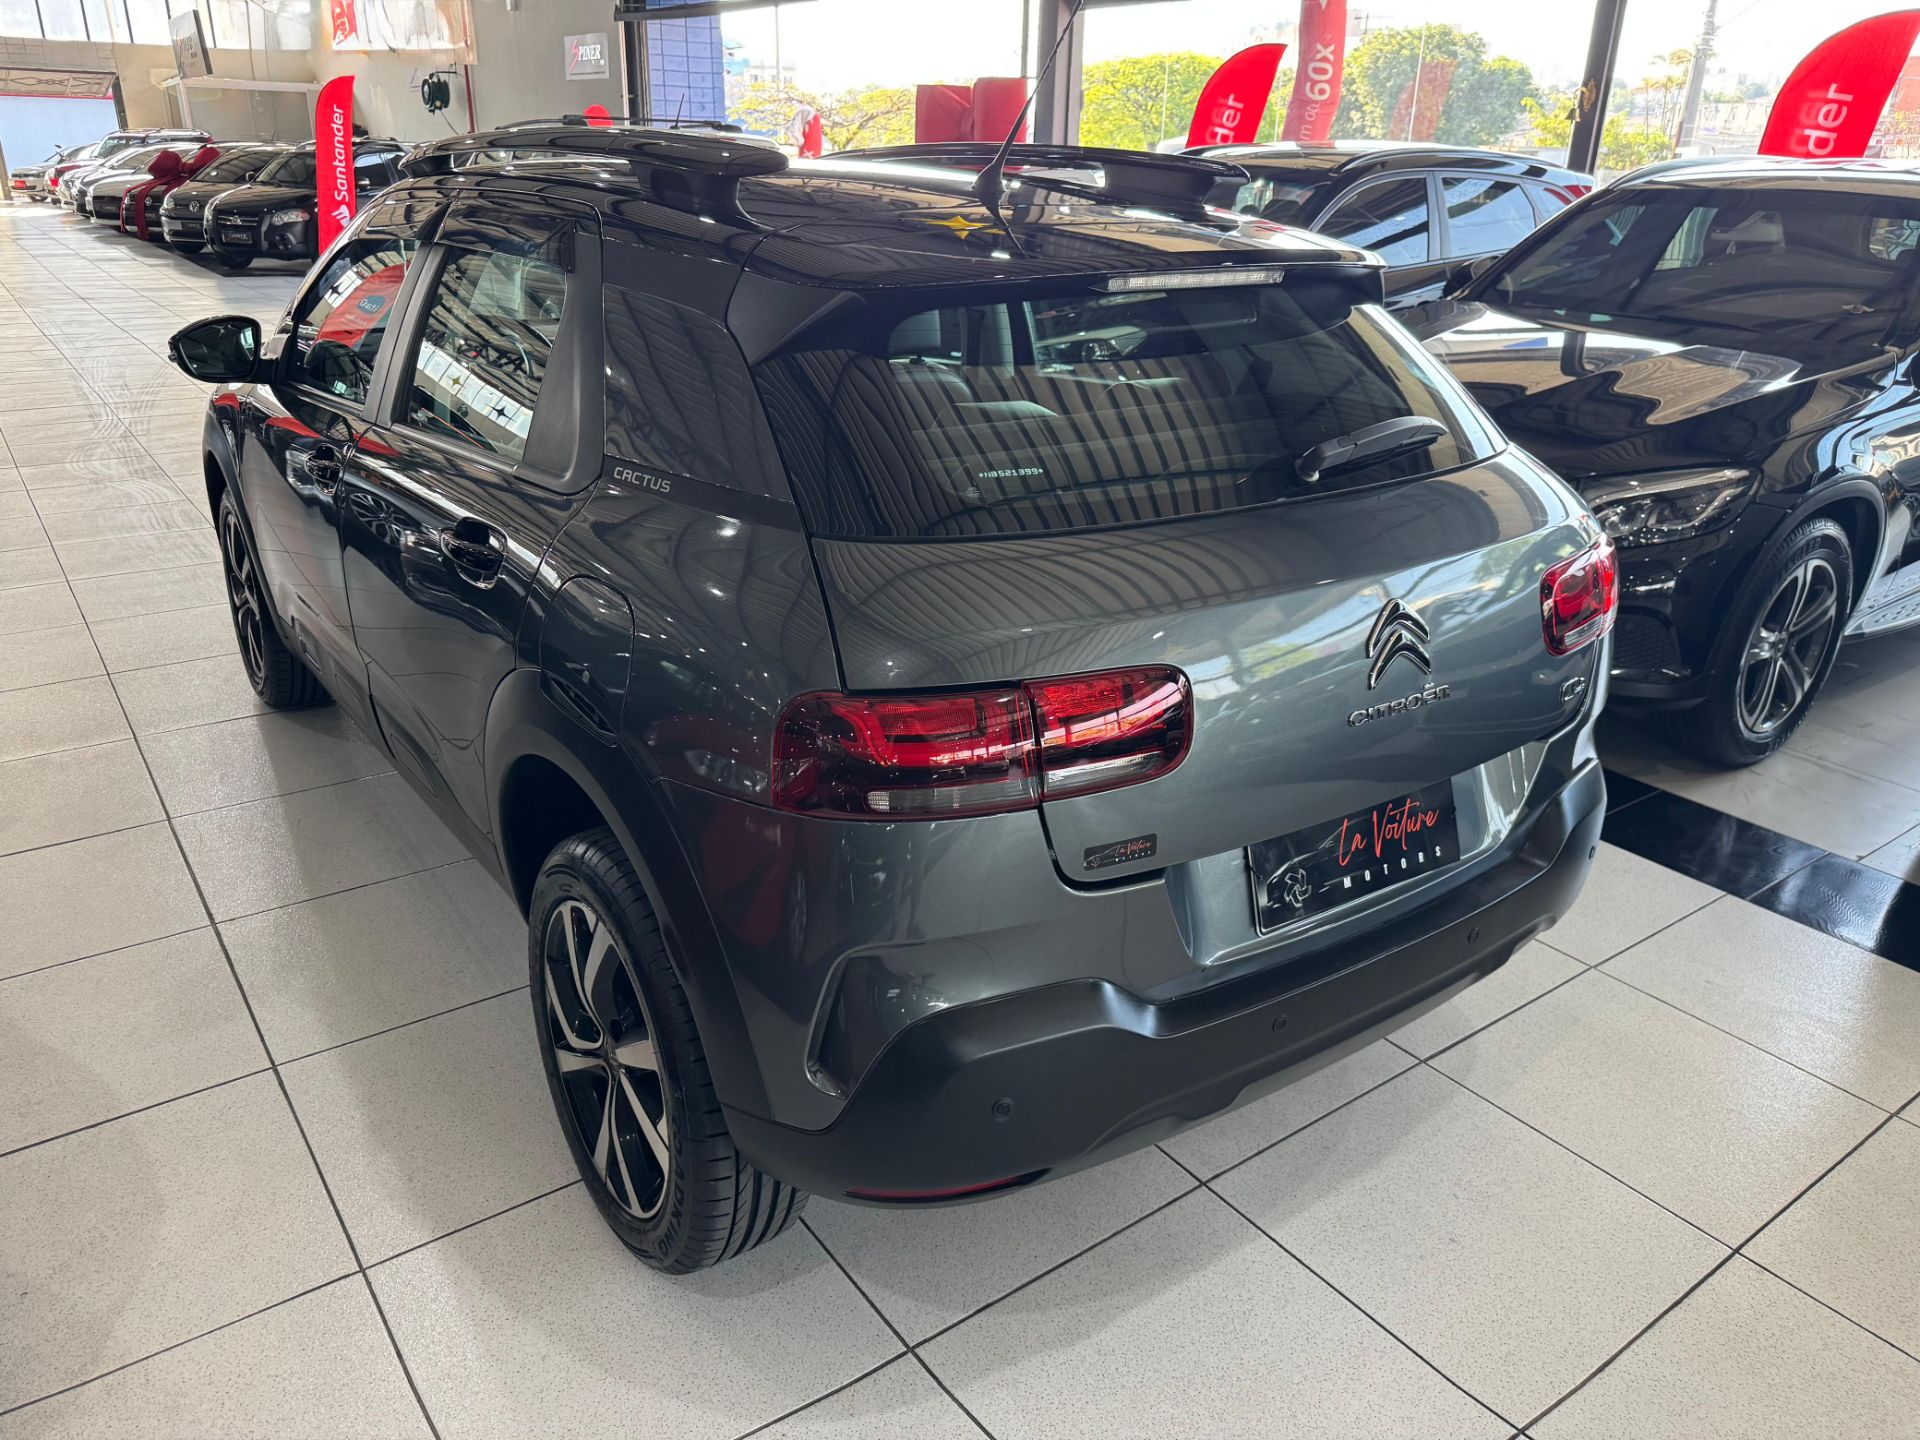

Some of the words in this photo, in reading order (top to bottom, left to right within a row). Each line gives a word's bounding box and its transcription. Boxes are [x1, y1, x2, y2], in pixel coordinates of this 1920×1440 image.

[1305, 43, 1335, 101] 60x
[331, 104, 349, 202] Santander
[613, 466, 672, 493] CACTUS
[1348, 683, 1450, 727] CITROËN
[1338, 818, 1367, 867] La
[1373, 798, 1440, 859] Voiture
[1343, 845, 1441, 889] MOTORS
